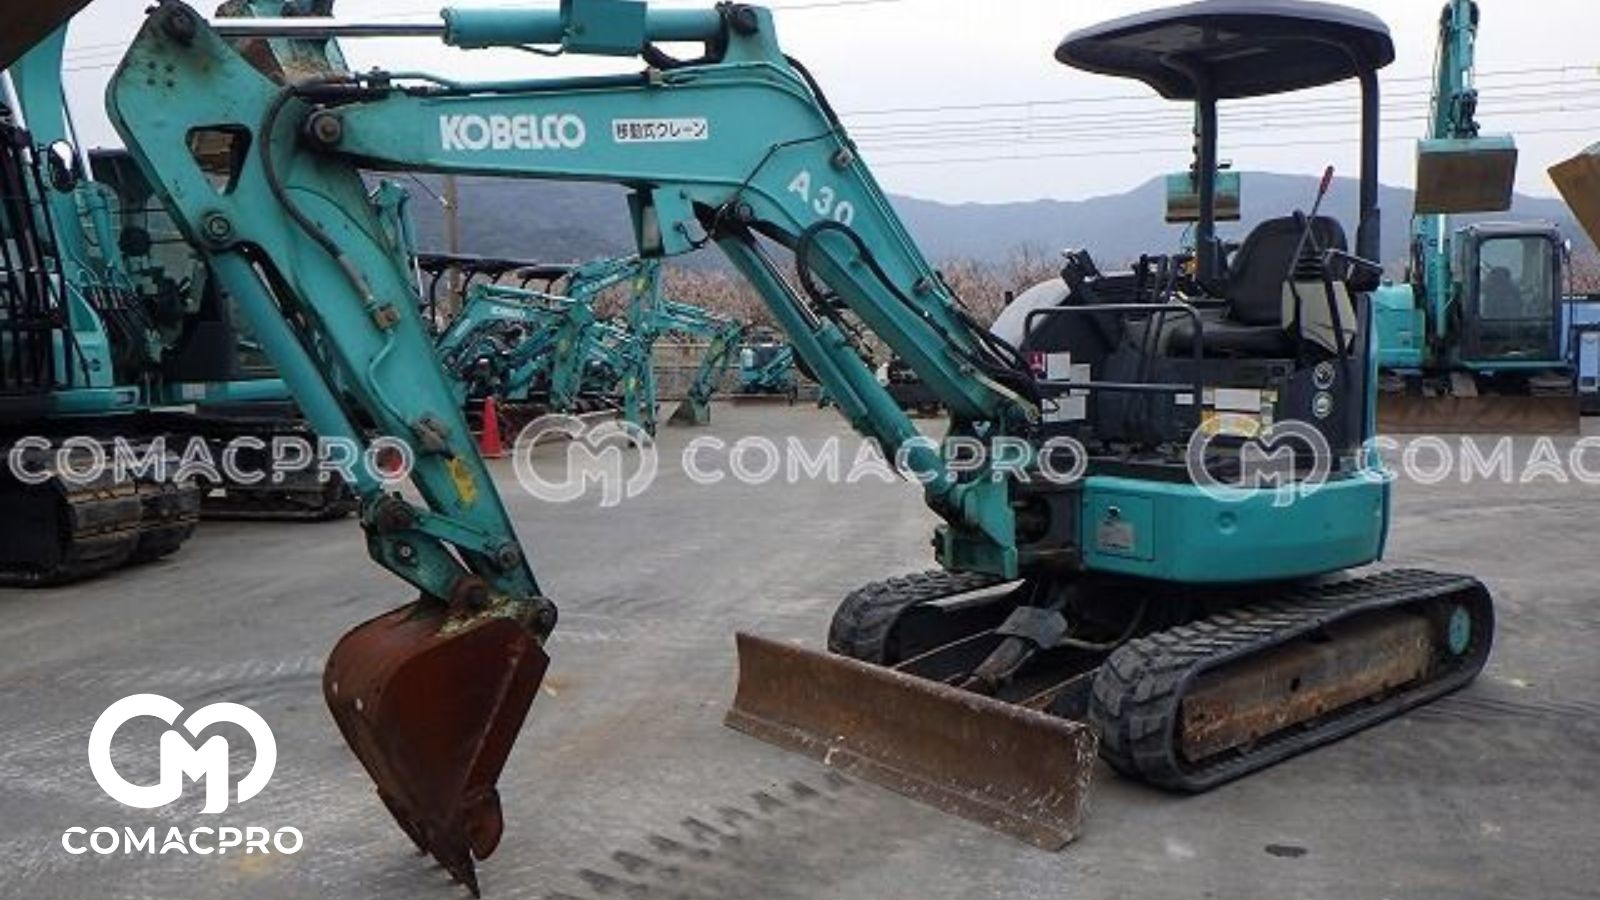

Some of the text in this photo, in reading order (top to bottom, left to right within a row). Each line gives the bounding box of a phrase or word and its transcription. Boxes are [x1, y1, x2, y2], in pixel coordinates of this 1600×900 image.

[439, 114, 586, 150] KOBELCO
[616, 122, 706, 140] 移動式クレーン
